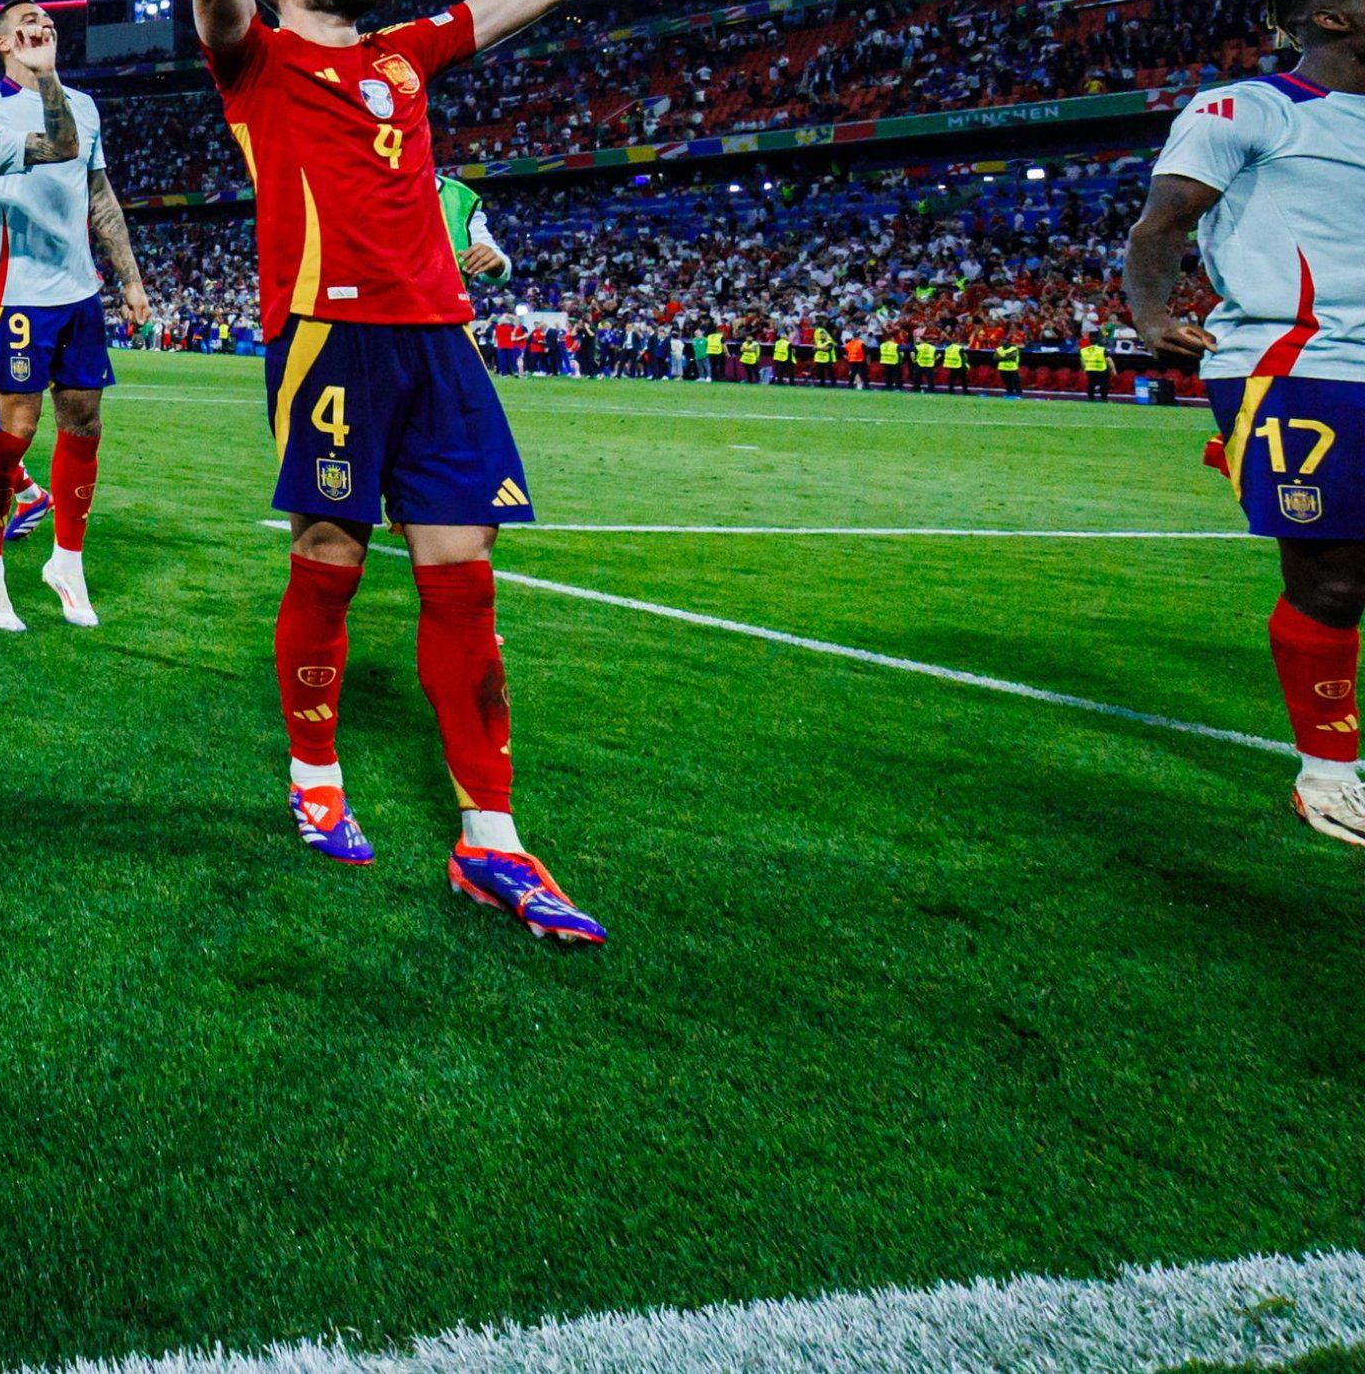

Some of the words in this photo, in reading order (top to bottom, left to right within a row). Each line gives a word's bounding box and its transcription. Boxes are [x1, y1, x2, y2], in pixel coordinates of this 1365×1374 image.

[373, 124, 403, 169] 4
[9, 313, 30, 349] 9
[311, 386, 349, 446] 4
[1255, 417, 1336, 475] 17
